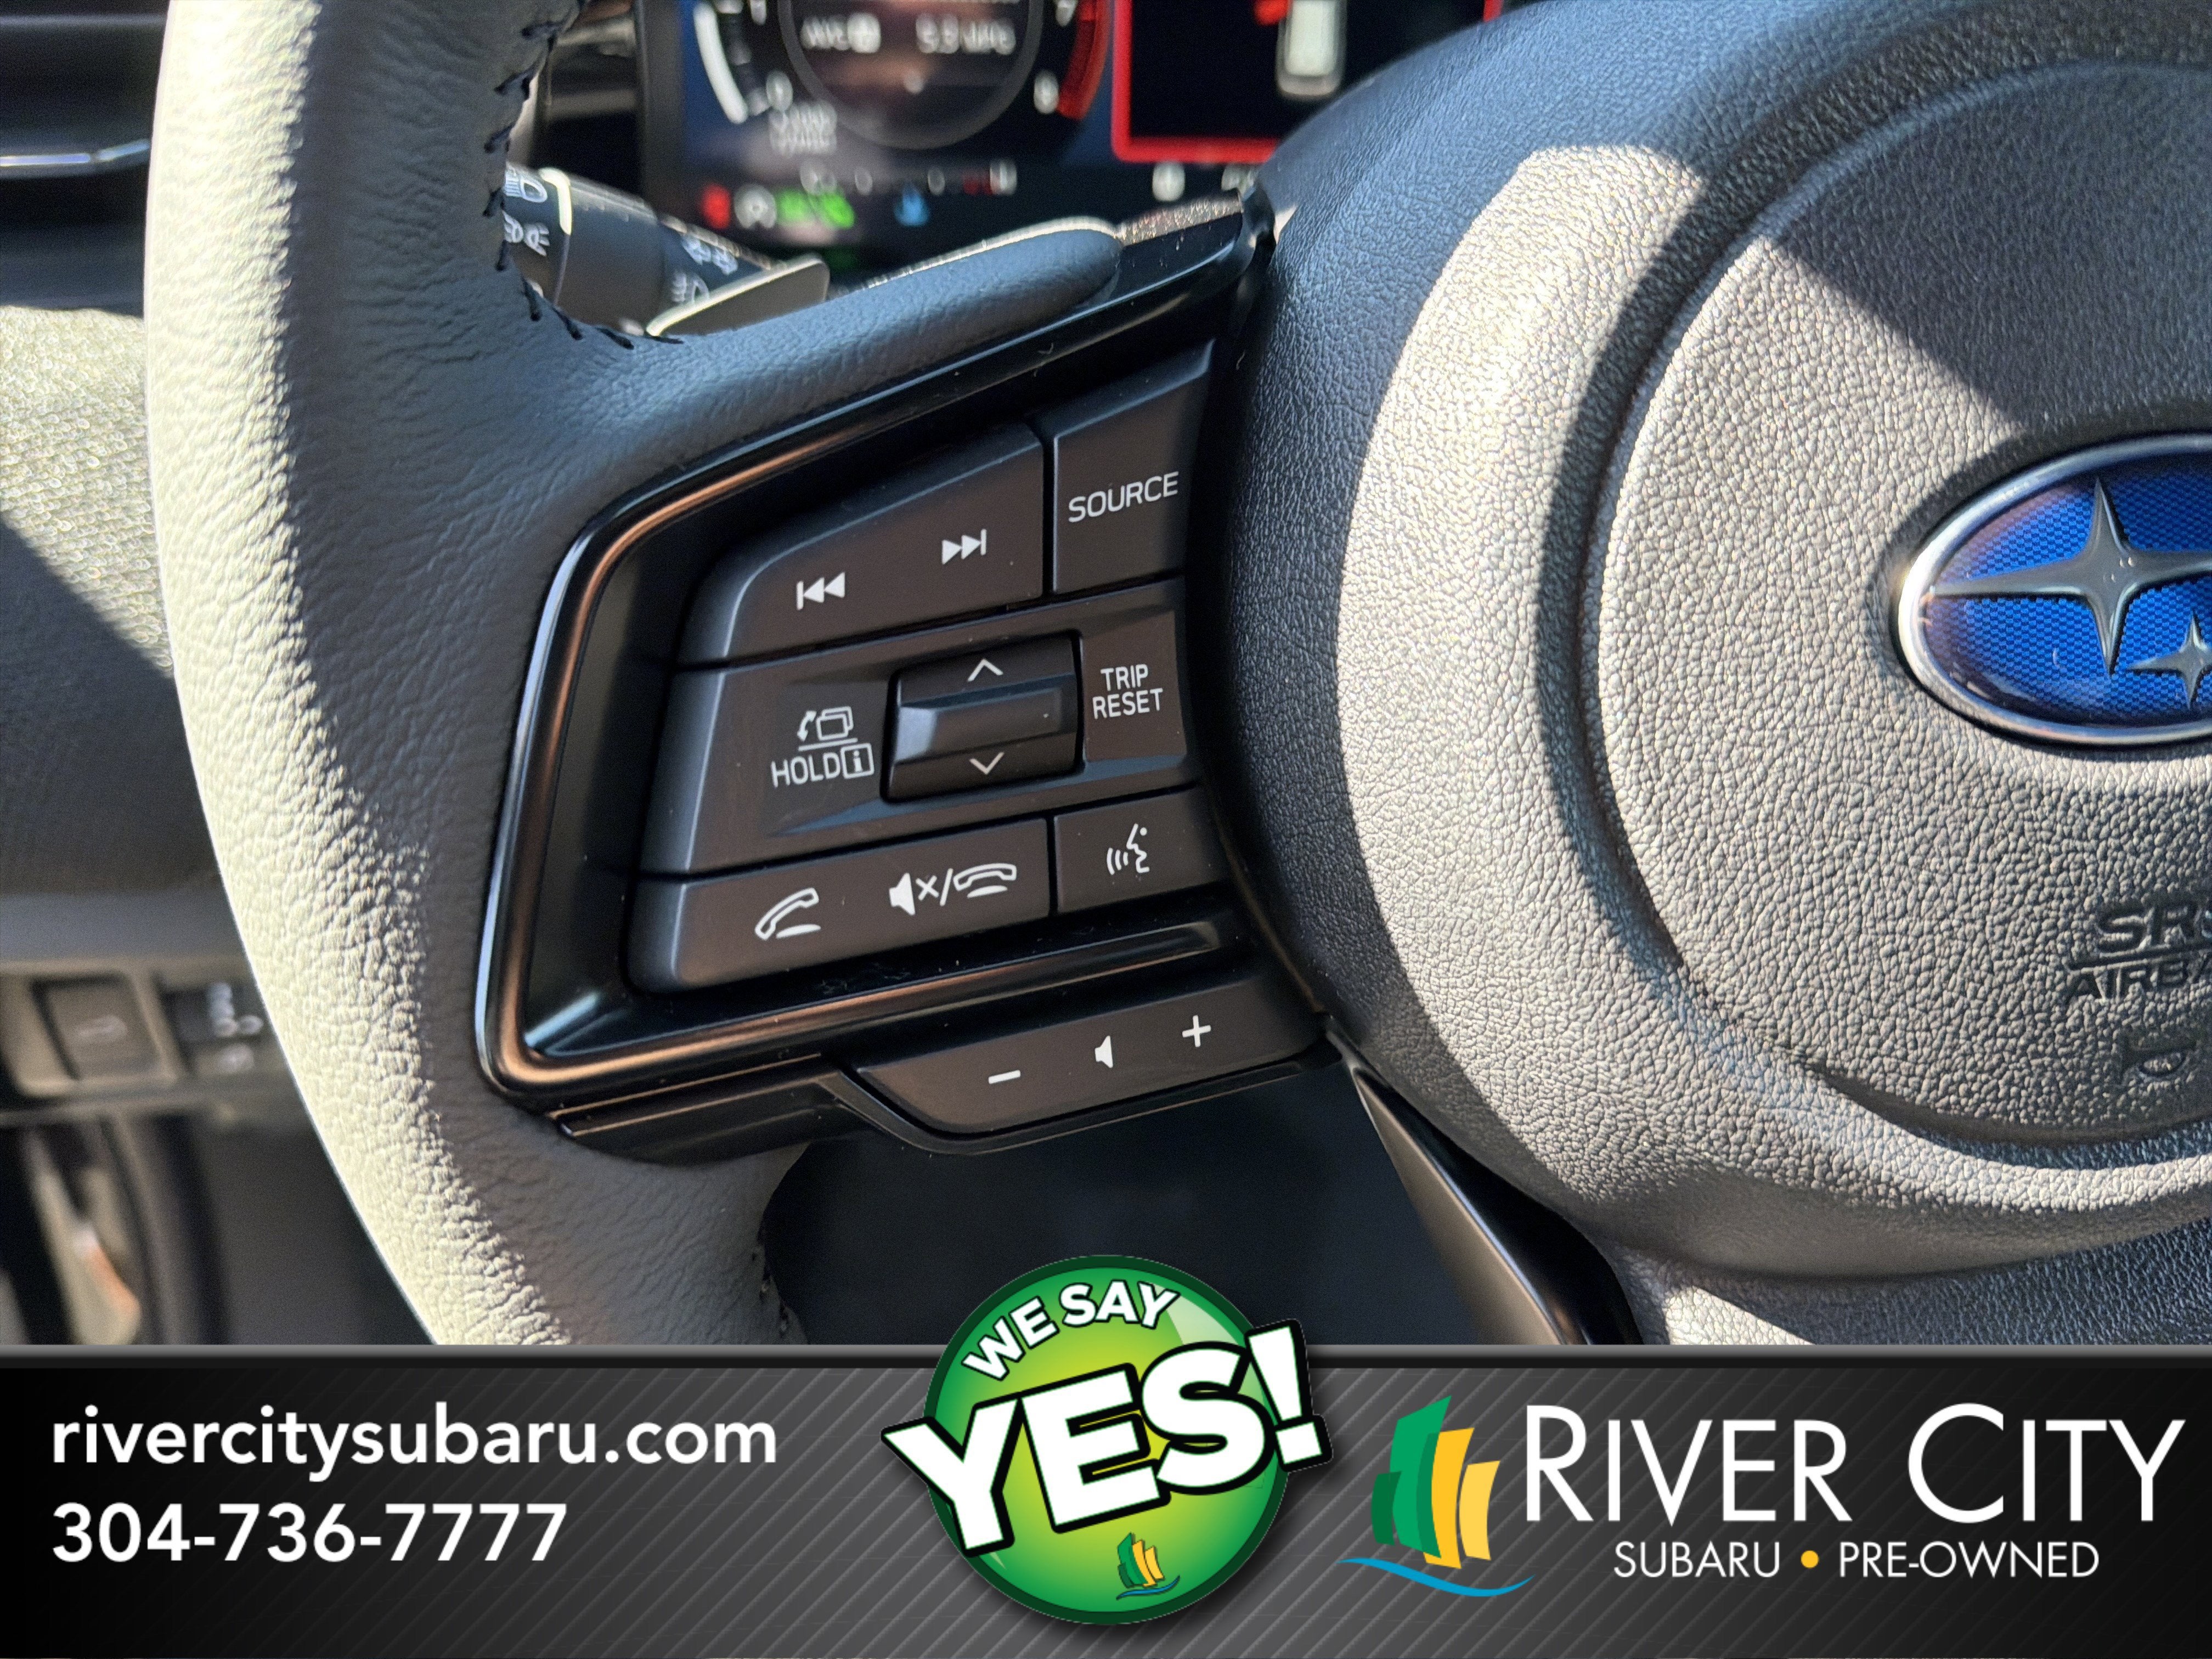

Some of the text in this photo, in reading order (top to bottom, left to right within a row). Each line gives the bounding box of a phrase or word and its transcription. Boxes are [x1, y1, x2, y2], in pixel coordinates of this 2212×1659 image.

[1068, 471, 1179, 522] SOURCE
[1100, 664, 1148, 691] TRIP
[1092, 687, 1163, 719] RESET
[770, 752, 840, 788] HOLD
[2098, 901, 2212, 953] SR
